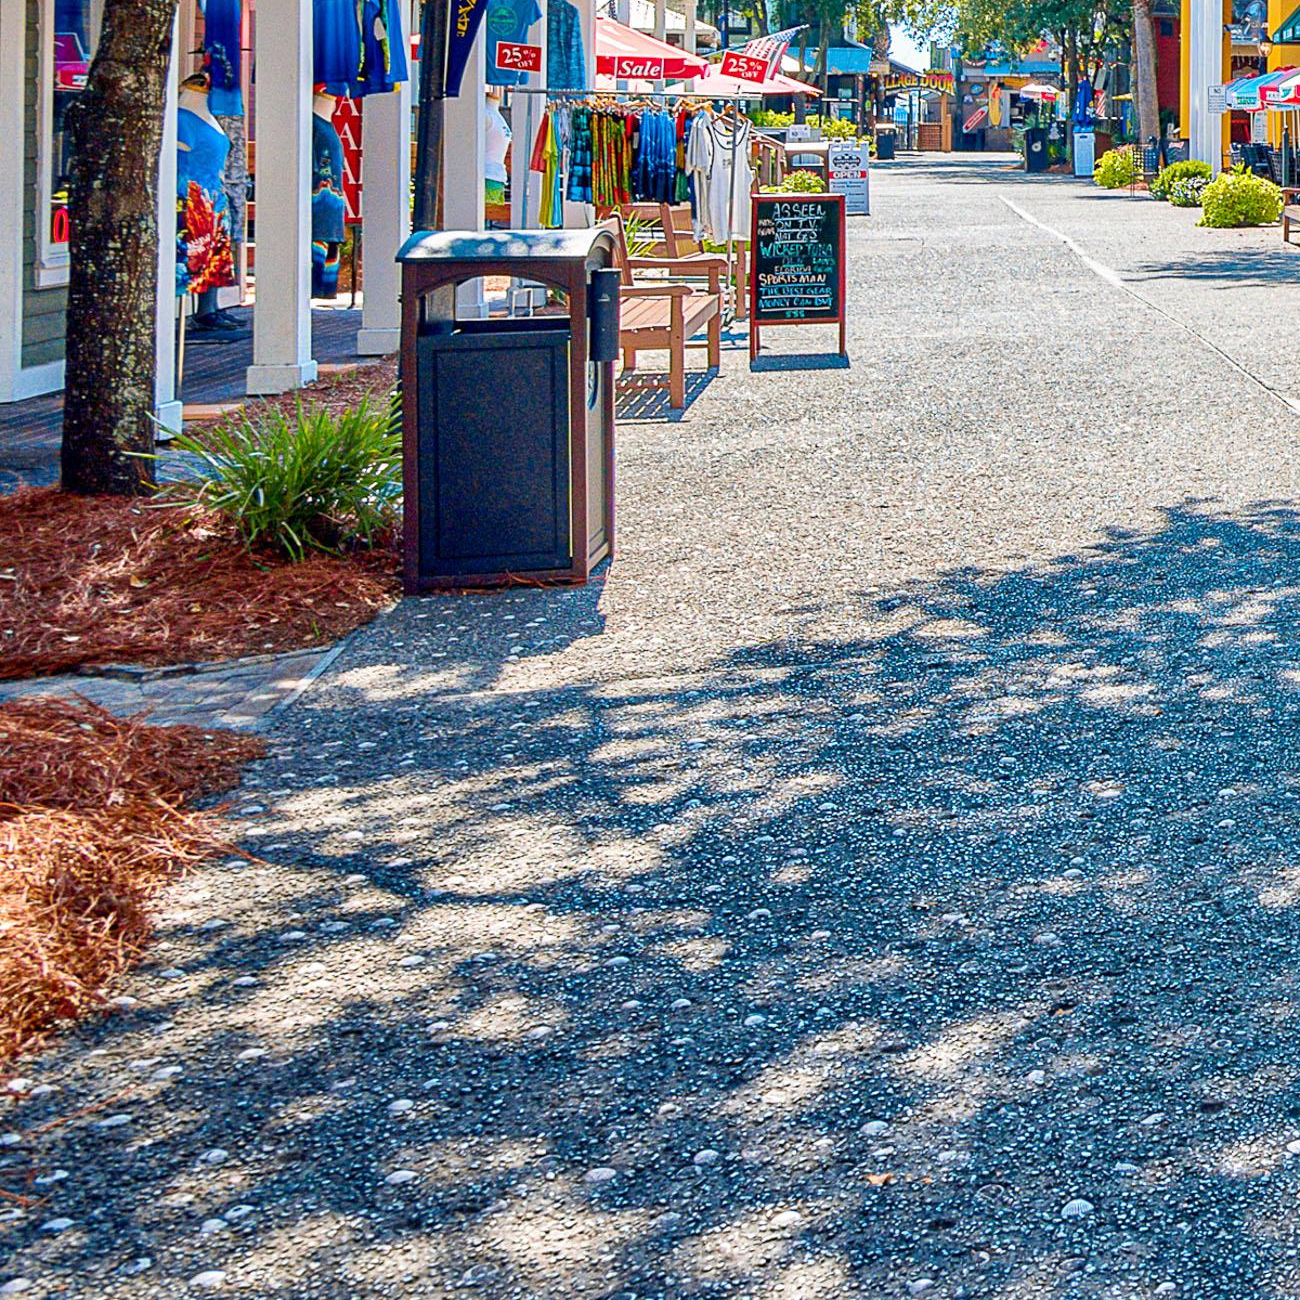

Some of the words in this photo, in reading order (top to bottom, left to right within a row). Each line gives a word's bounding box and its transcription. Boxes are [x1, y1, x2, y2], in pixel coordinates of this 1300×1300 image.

[502, 47, 536, 64] 25%
[517, 60, 534, 69] OFF
[618, 60, 661, 77] Sale
[727, 58, 762, 73] 25%
[920, 74, 954, 95] DOOR
[833, 171, 861, 179] OPEN
